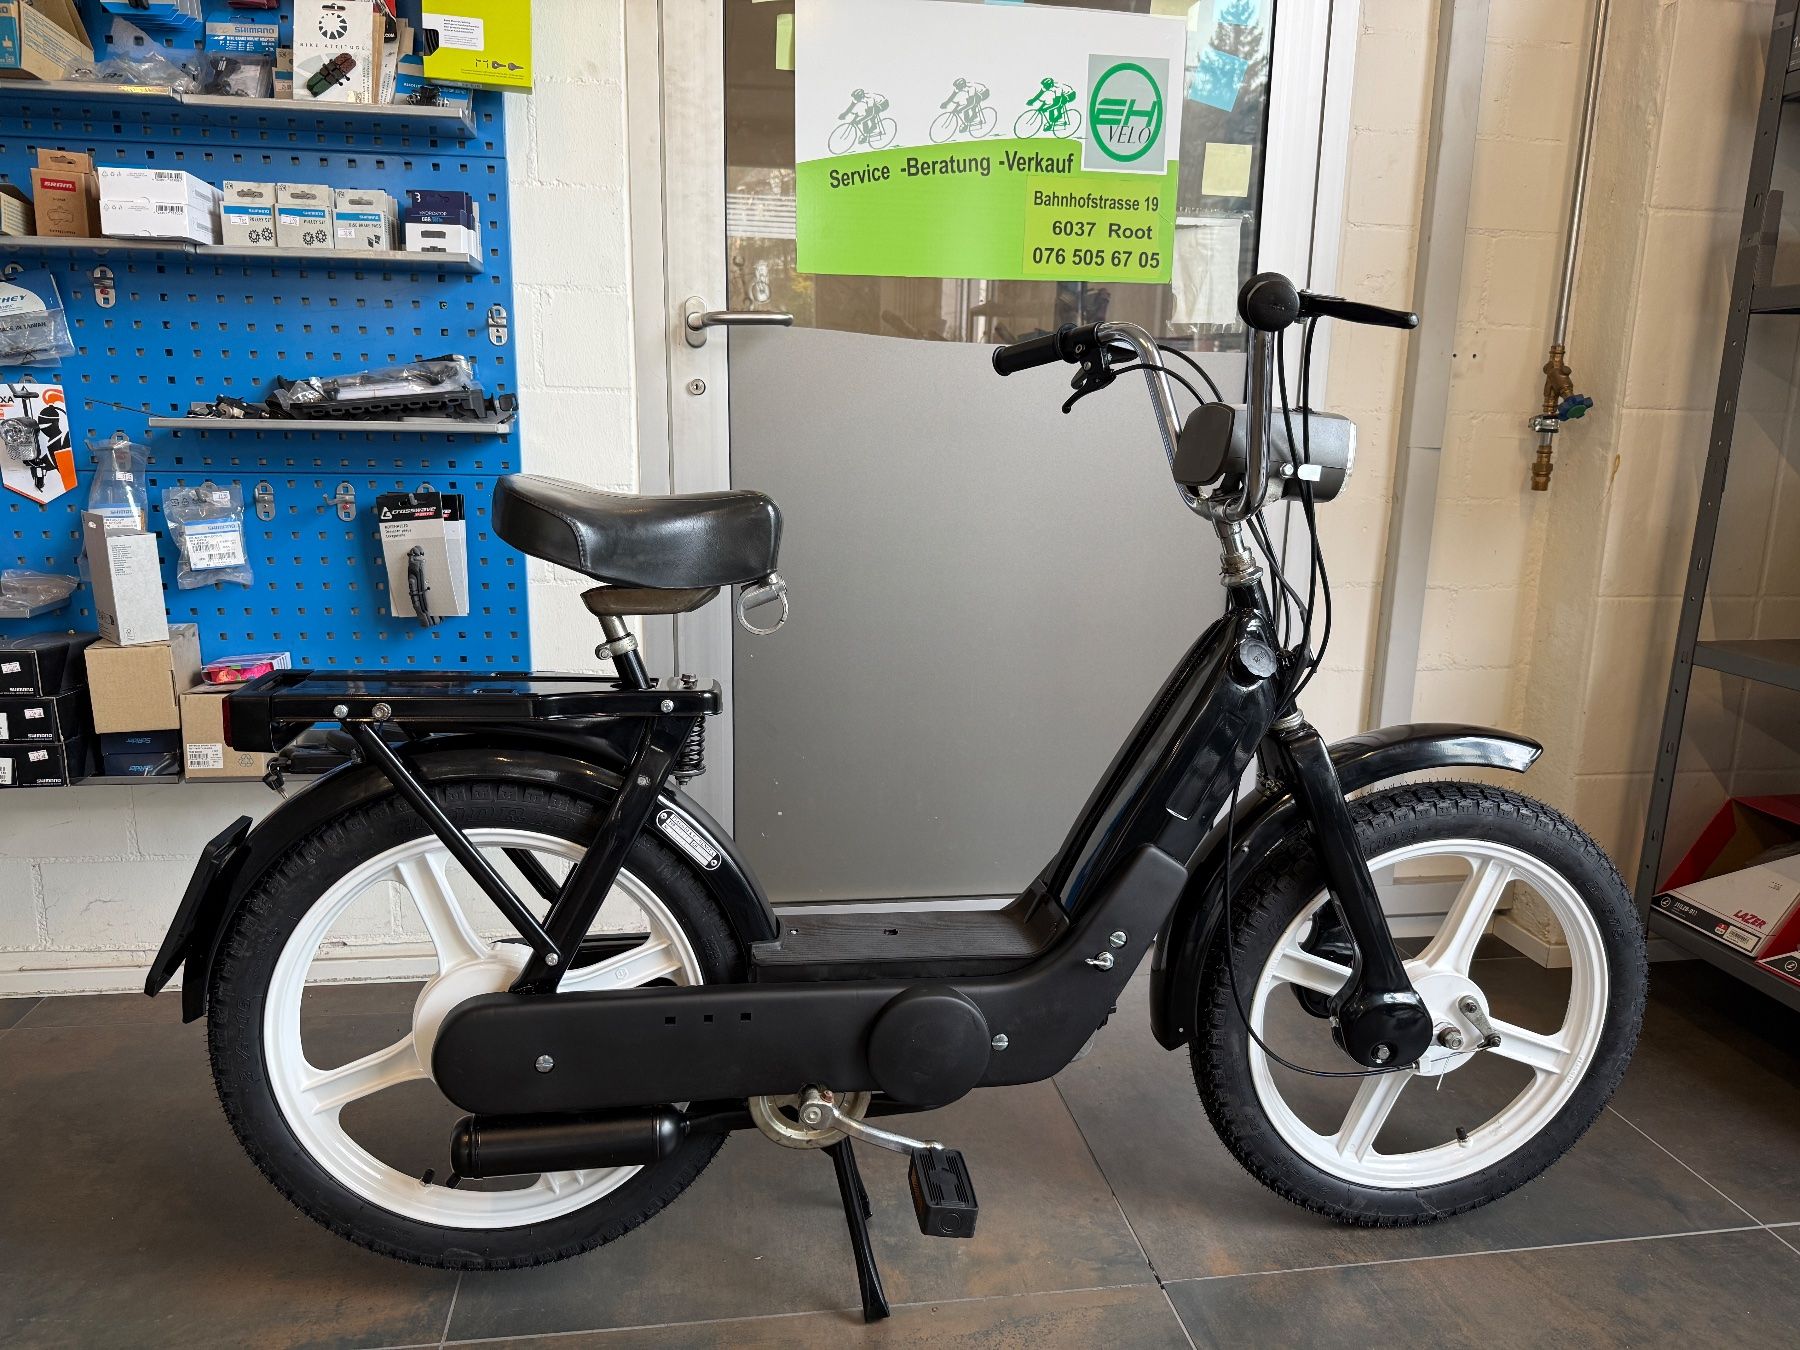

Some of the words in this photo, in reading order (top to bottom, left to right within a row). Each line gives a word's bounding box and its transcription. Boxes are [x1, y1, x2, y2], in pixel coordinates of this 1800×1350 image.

[234, 26, 275, 35] SHIMANO
[1109, 125, 1151, 144] VELO
[829, 163, 891, 189] Service
[900, 154, 991, 177] -Beratung
[998, 150, 1075, 174] -Verkauf
[43, 181, 73, 189] SRAM
[1033, 190, 1140, 211] Bahnhofstrasse
[1145, 196, 1159, 212] 19
[1052, 220, 1097, 237] 6037
[1108, 222, 1153, 240] Root
[1032, 246, 1066, 265] 076
[1072, 248, 1105, 267] 505
[1111, 250, 1133, 267] 67
[1138, 251, 1160, 269] 05
[1732, 909, 1767, 929] LAZER
